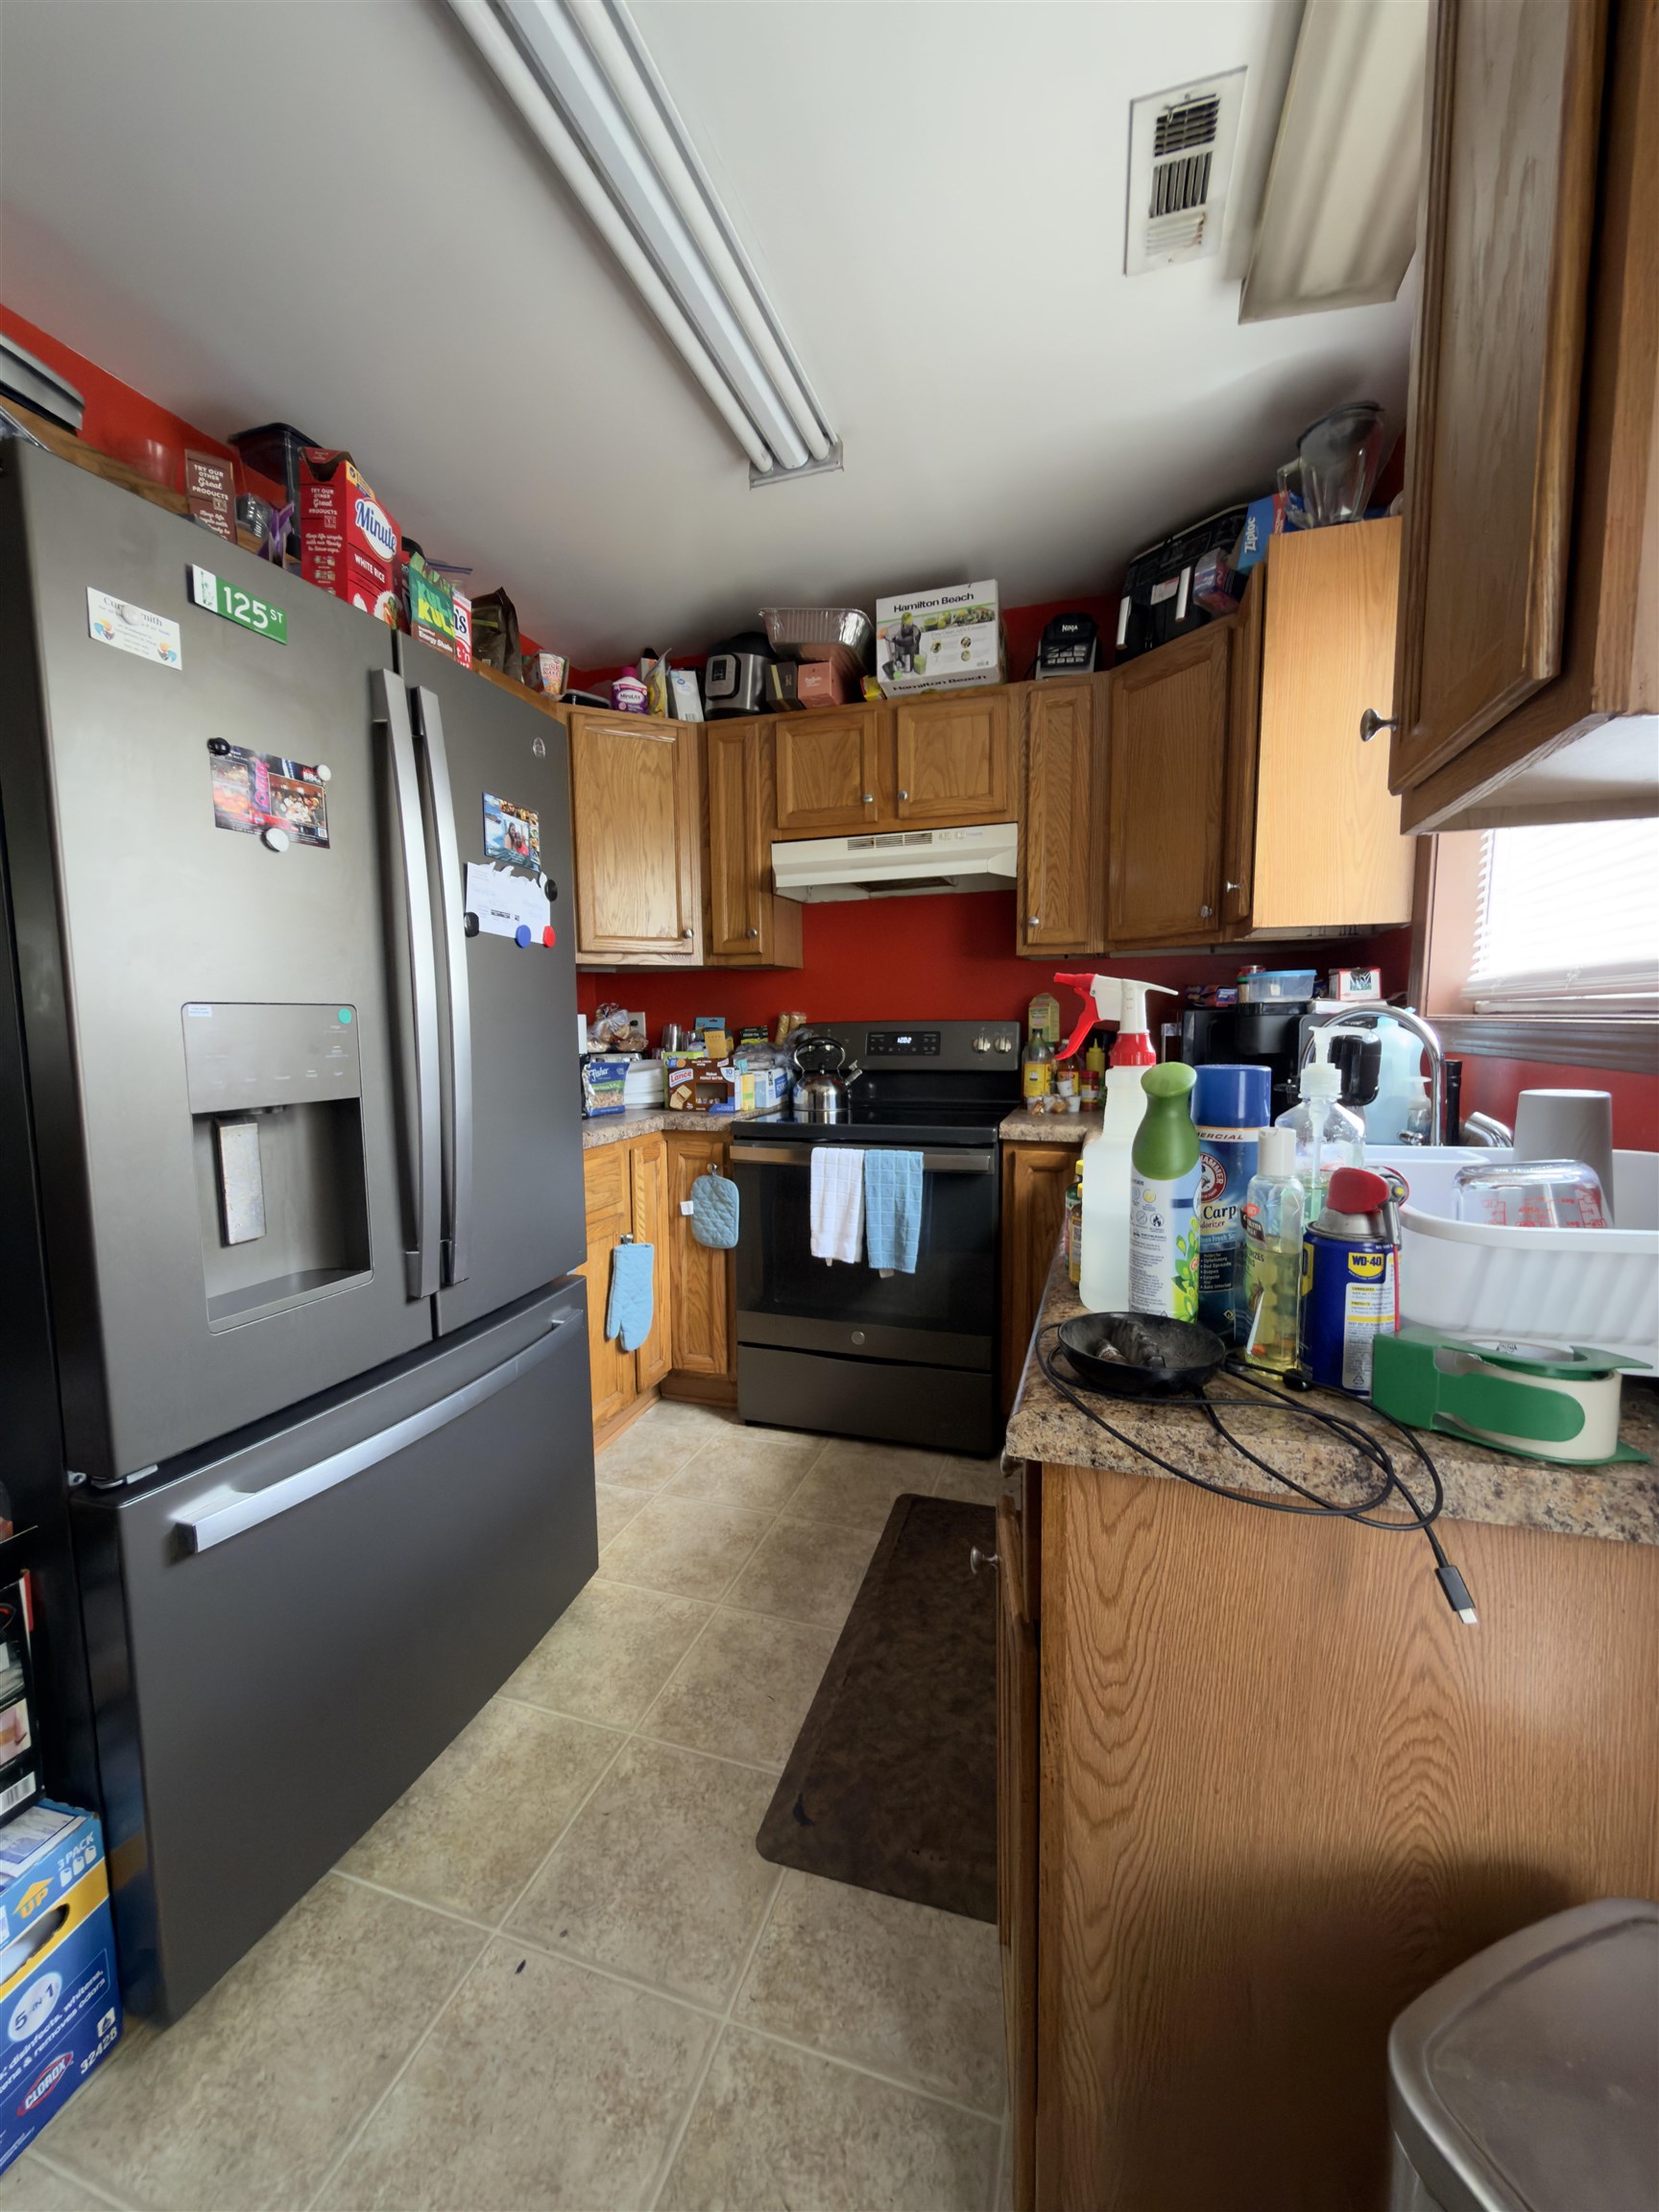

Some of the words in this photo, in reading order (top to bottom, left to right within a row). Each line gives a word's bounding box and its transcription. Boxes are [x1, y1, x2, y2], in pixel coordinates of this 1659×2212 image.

[194, 464, 207, 472] TRY
[208, 469, 224, 477] OUR
[199, 471, 220, 481] OTHER
[192, 486, 229, 500] PRODUCTS
[198, 477, 223, 491] Great
[313, 498, 333, 509] Great
[356, 500, 396, 553] Minute
[1244, 517, 1258, 554] Ziploc
[354, 553, 373, 575] WHITE
[373, 566, 385, 583] RICE
[223, 587, 269, 629] 125
[270, 609, 283, 624] ST
[894, 599, 940, 613] Hamilton
[941, 592, 974, 606] Beach
[1062, 624, 1078, 633] NINJA
[893, 679, 947, 691] Hamilton
[948, 674, 987, 685] Beach
[589, 1066, 611, 1082] Fisher
[670, 1070, 692, 1083] Lance
[1352, 1255, 1382, 1266] WD-40
[57, 1858, 65, 1872] 3
[65, 1831, 94, 1865] PACK
[20, 1887, 49, 1919] UP
[9, 2013, 63, 2070] disinfects,
[63, 1970, 104, 2013] whitens,
[23, 2056, 33, 2068] &
[34, 2008, 78, 2057] removes
[78, 1978, 106, 2009] odors
[25, 2058, 67, 2110] CLOROX
